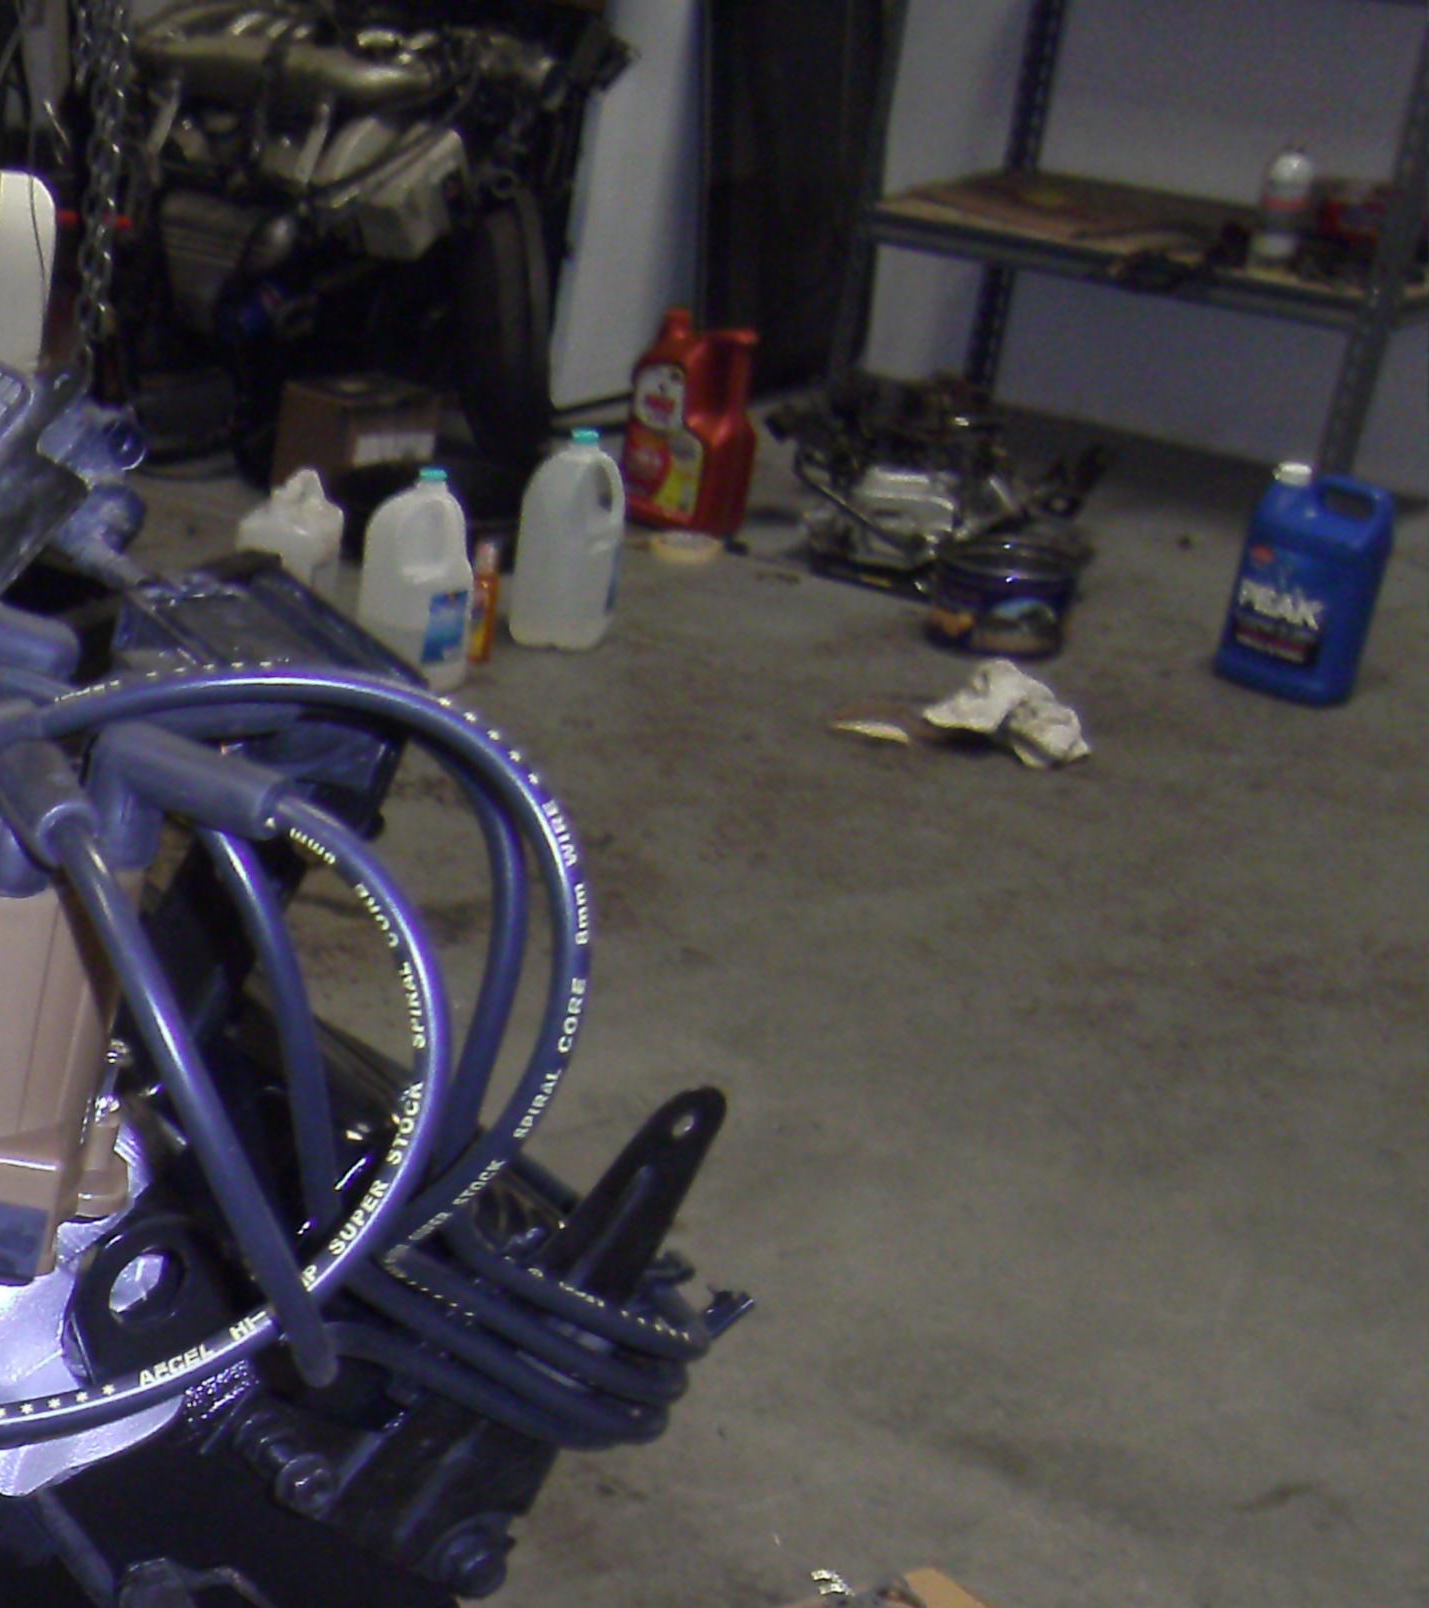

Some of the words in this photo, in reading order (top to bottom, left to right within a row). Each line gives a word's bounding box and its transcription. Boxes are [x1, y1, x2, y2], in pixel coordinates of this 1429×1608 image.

[542, 799, 579, 867] WIRE
[573, 883, 589, 945] 8mm
[557, 977, 588, 1054] CORE
[512, 1068, 562, 1140] SPIRAL
[328, 1179, 390, 1256] SUPER
[385, 1081, 424, 1166] STOCK
[451, 1158, 508, 1206] STOCK
